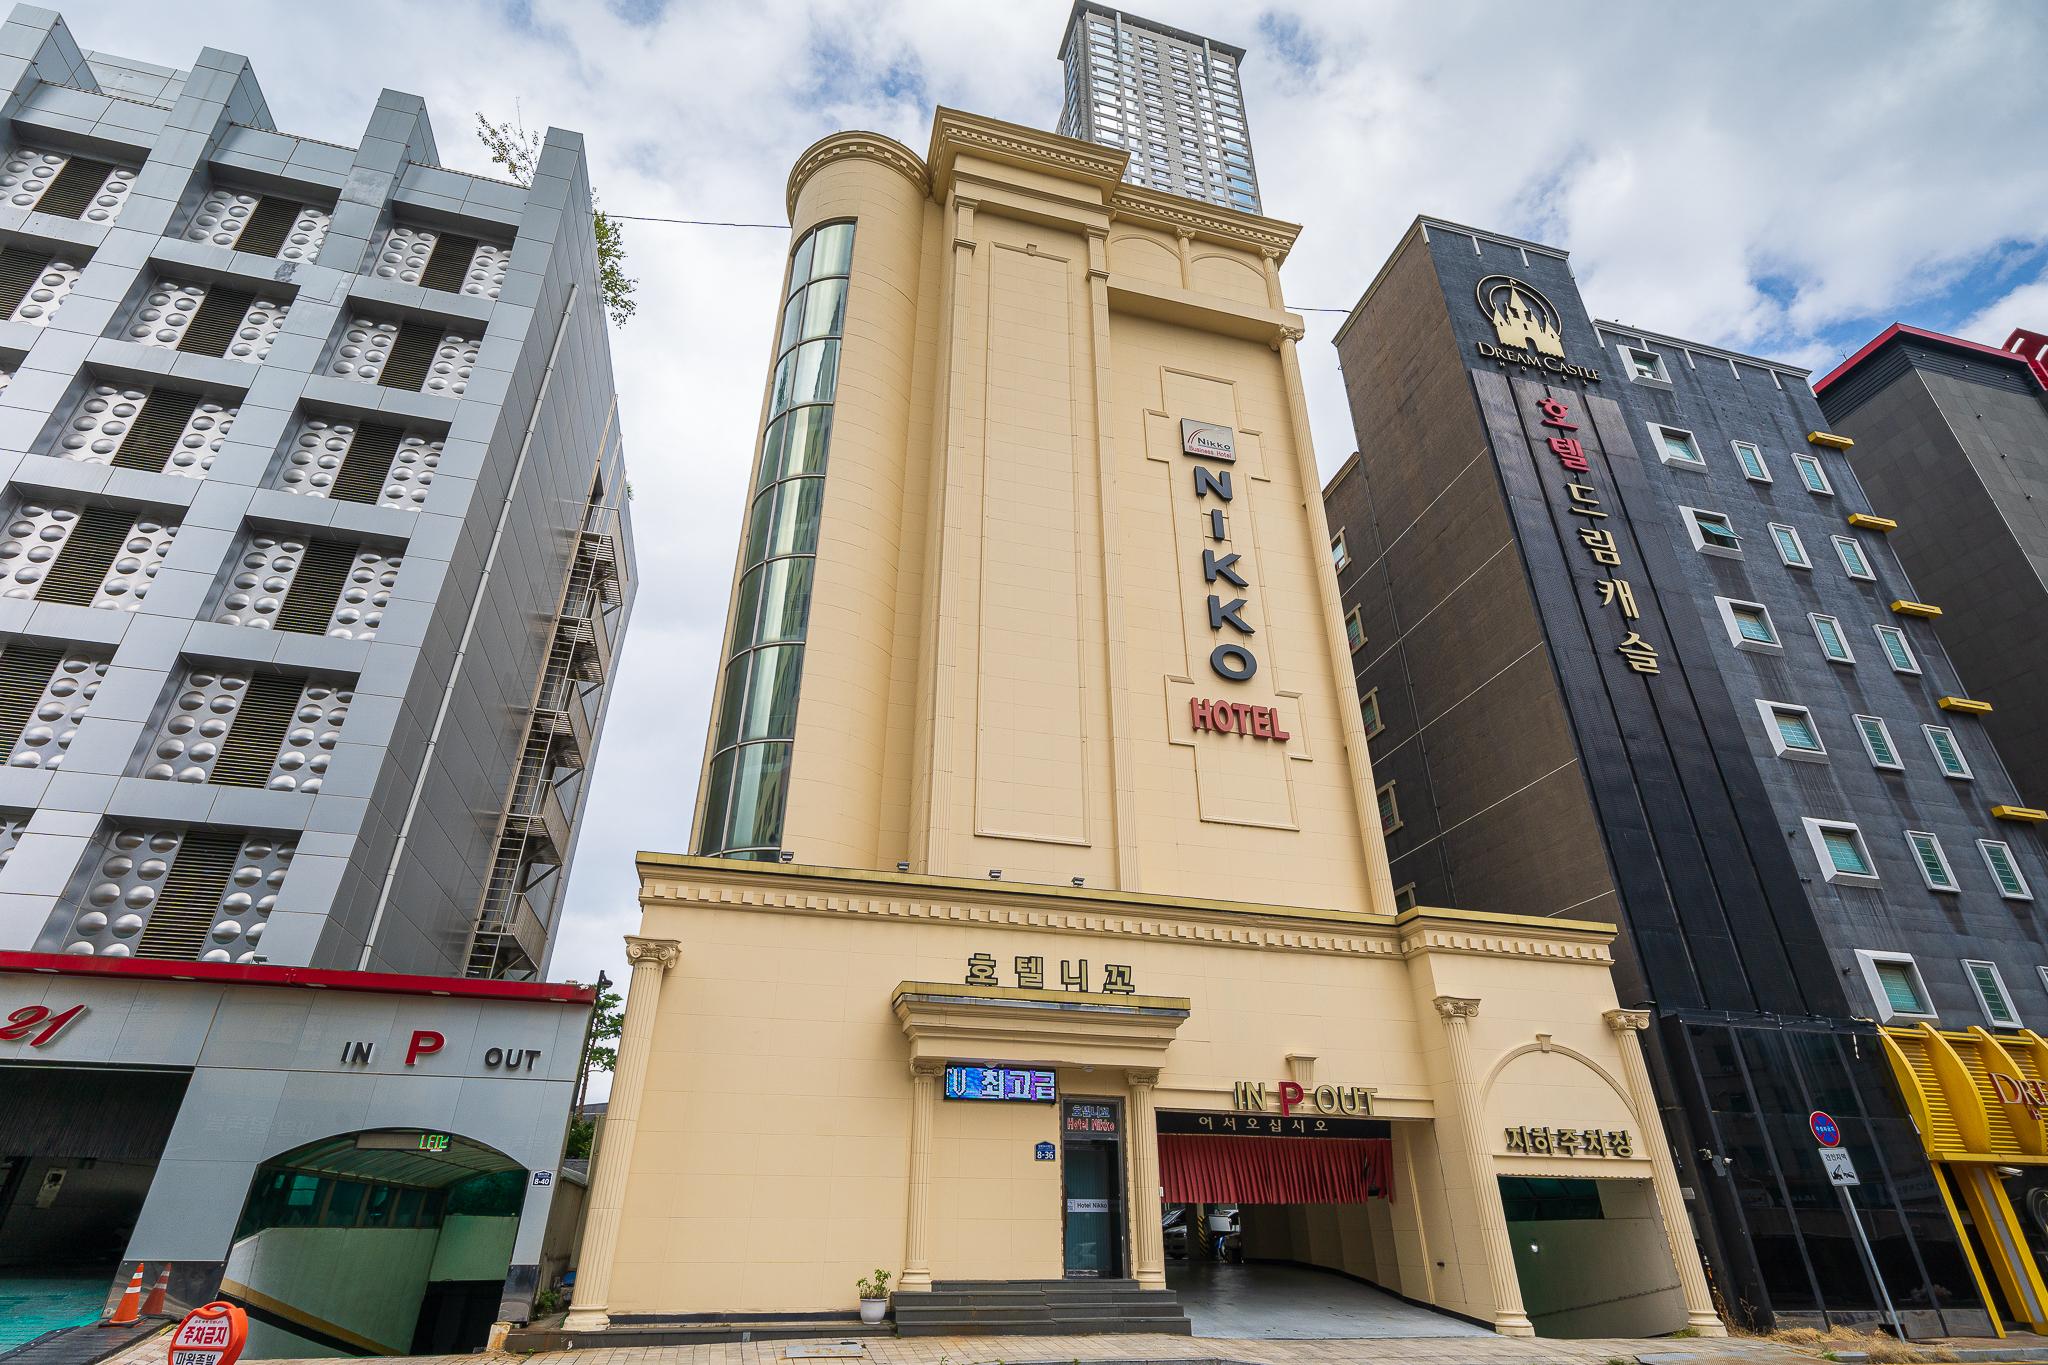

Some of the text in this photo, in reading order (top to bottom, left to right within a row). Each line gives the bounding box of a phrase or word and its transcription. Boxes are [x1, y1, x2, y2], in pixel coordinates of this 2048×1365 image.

[1476, 341, 1603, 381] DREAM CASTLE
[1188, 445, 1232, 459] Business Hotel
[1197, 436, 1231, 451] Nikko
[1193, 465, 1258, 681] NIKKO
[1190, 697, 1290, 742] HOTEL
[340, 1029, 542, 1071] IN P OUT
[980, 1068, 1055, 1100] 최고급
[1234, 1081, 1378, 1116] IN P OUT
[1067, 1117, 1115, 1132] Hotel Nikko
[1199, 1116, 1329, 1134] 어서오십시오
[1037, 1151, 1054, 1159] 8-36
[1503, 1126, 1634, 1157] 지하주차장
[184, 1326, 227, 1344] 주차금지
